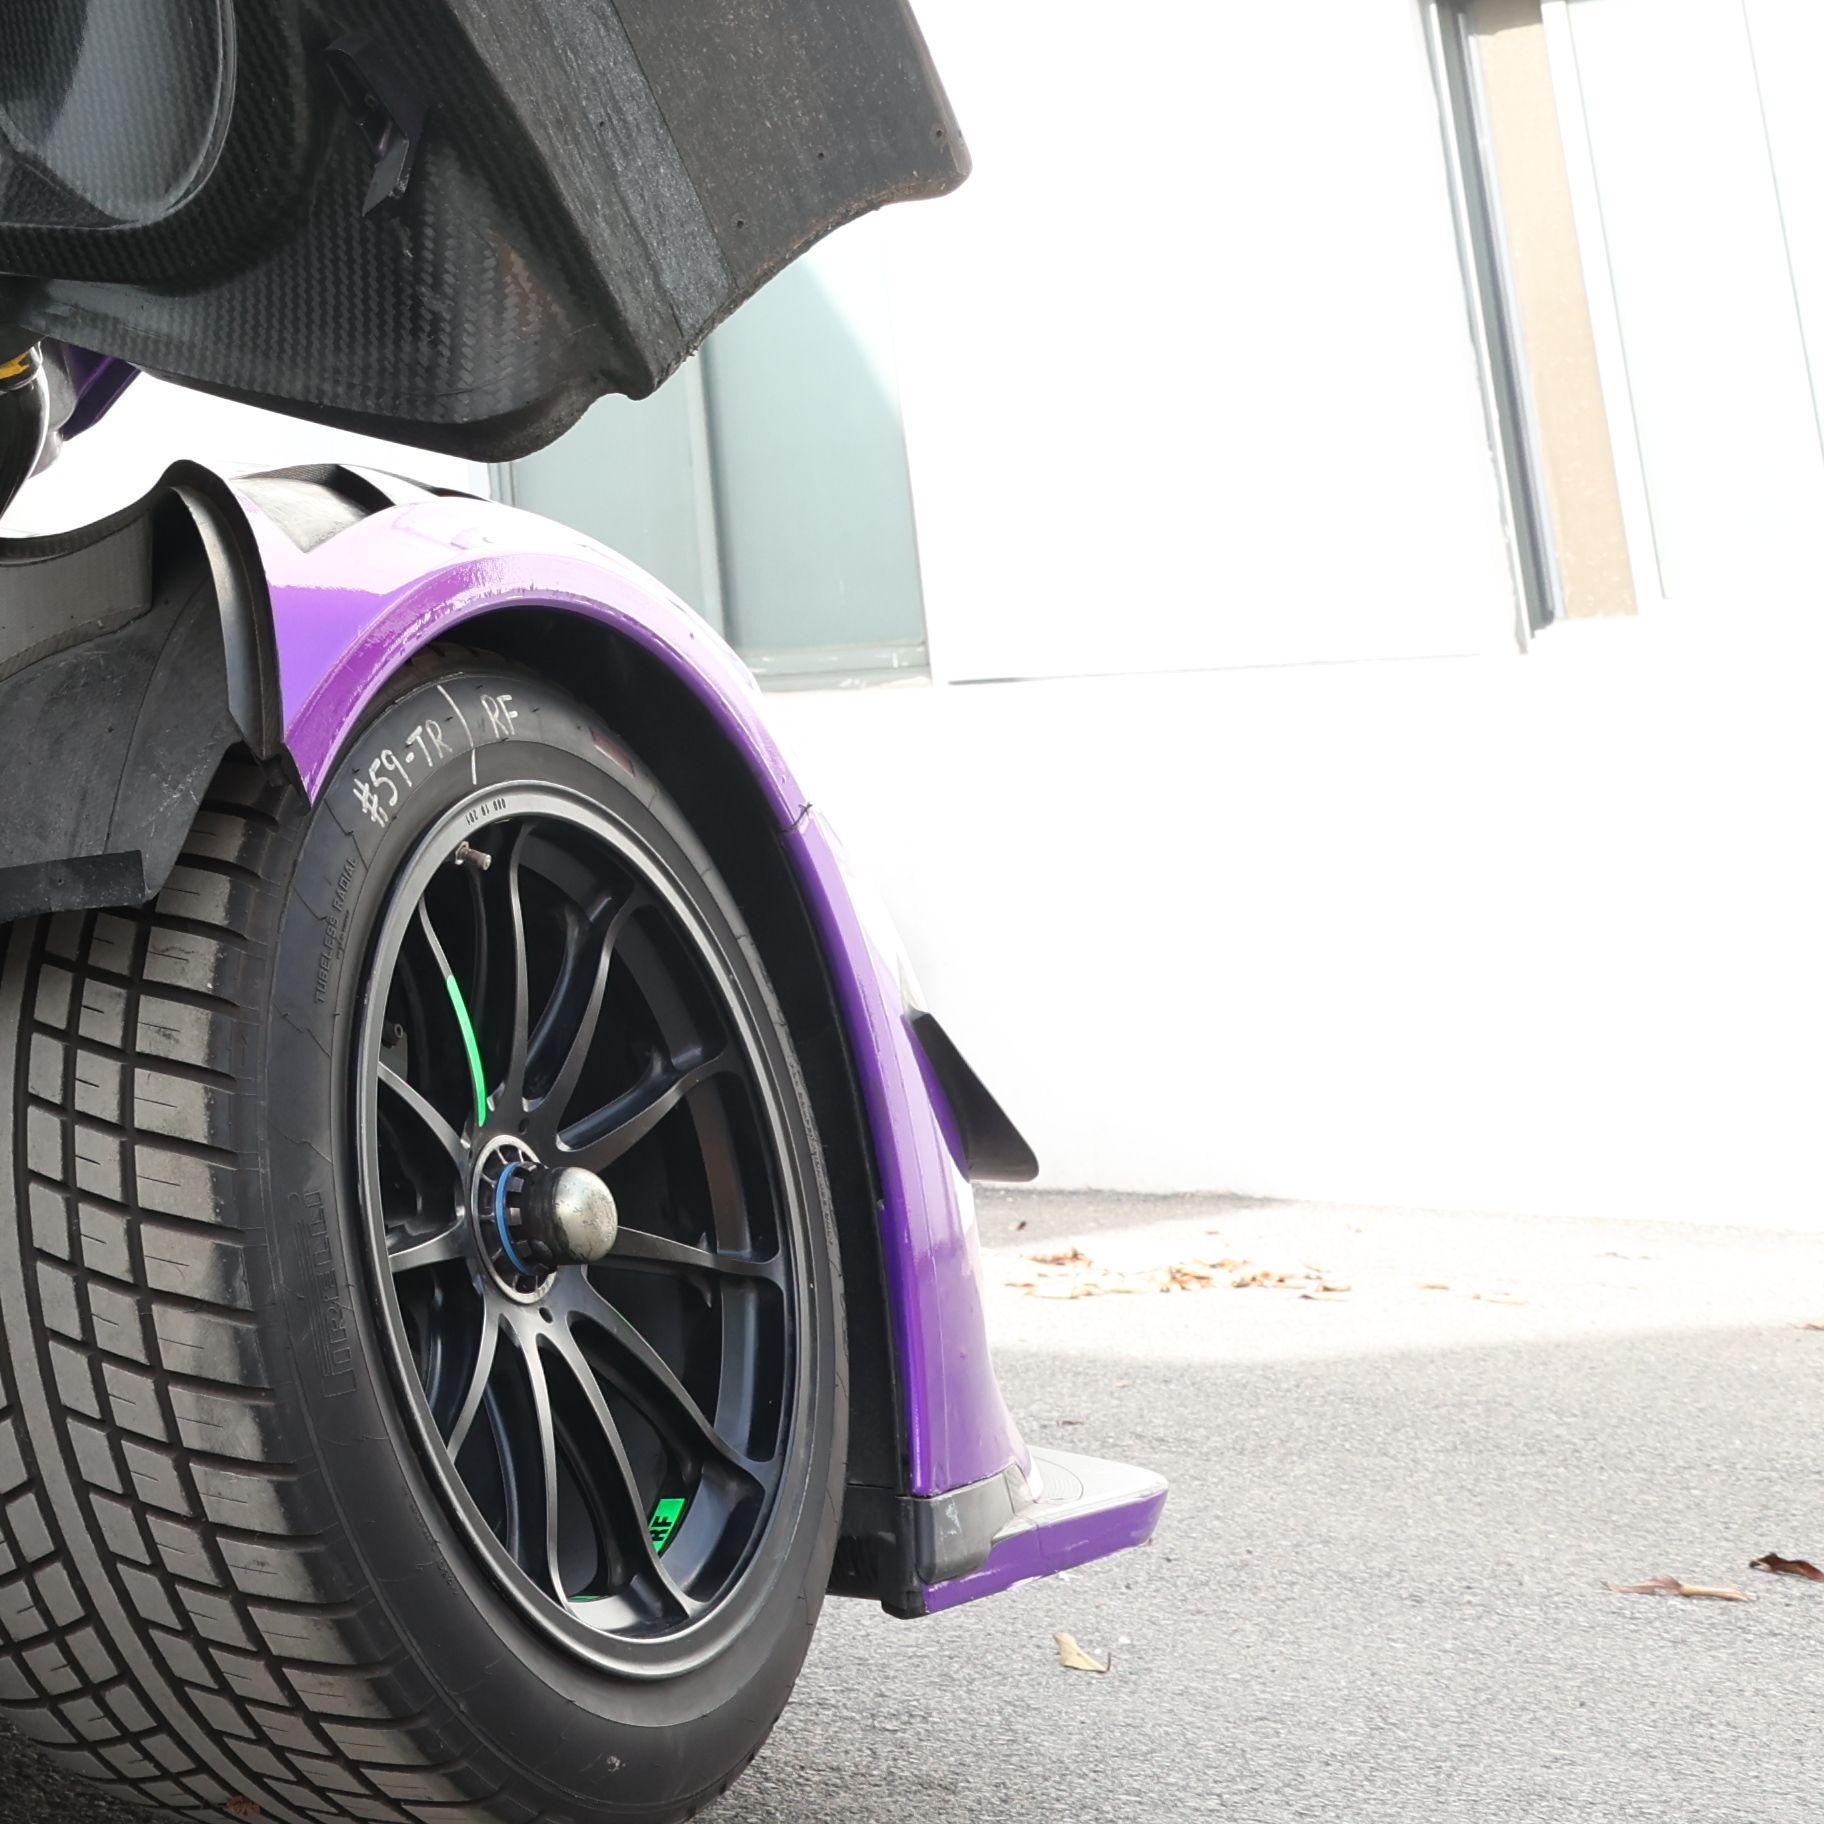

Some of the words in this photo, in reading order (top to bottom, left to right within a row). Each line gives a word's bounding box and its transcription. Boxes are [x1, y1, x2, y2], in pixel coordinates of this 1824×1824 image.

[354, 720, 454, 827] #59-TR
[481, 694, 519, 740] RF
[315, 914, 340, 1003] TUBELESS
[332, 857, 356, 910] RADIAL
[299, 1191, 356, 1398] PIRELLI
